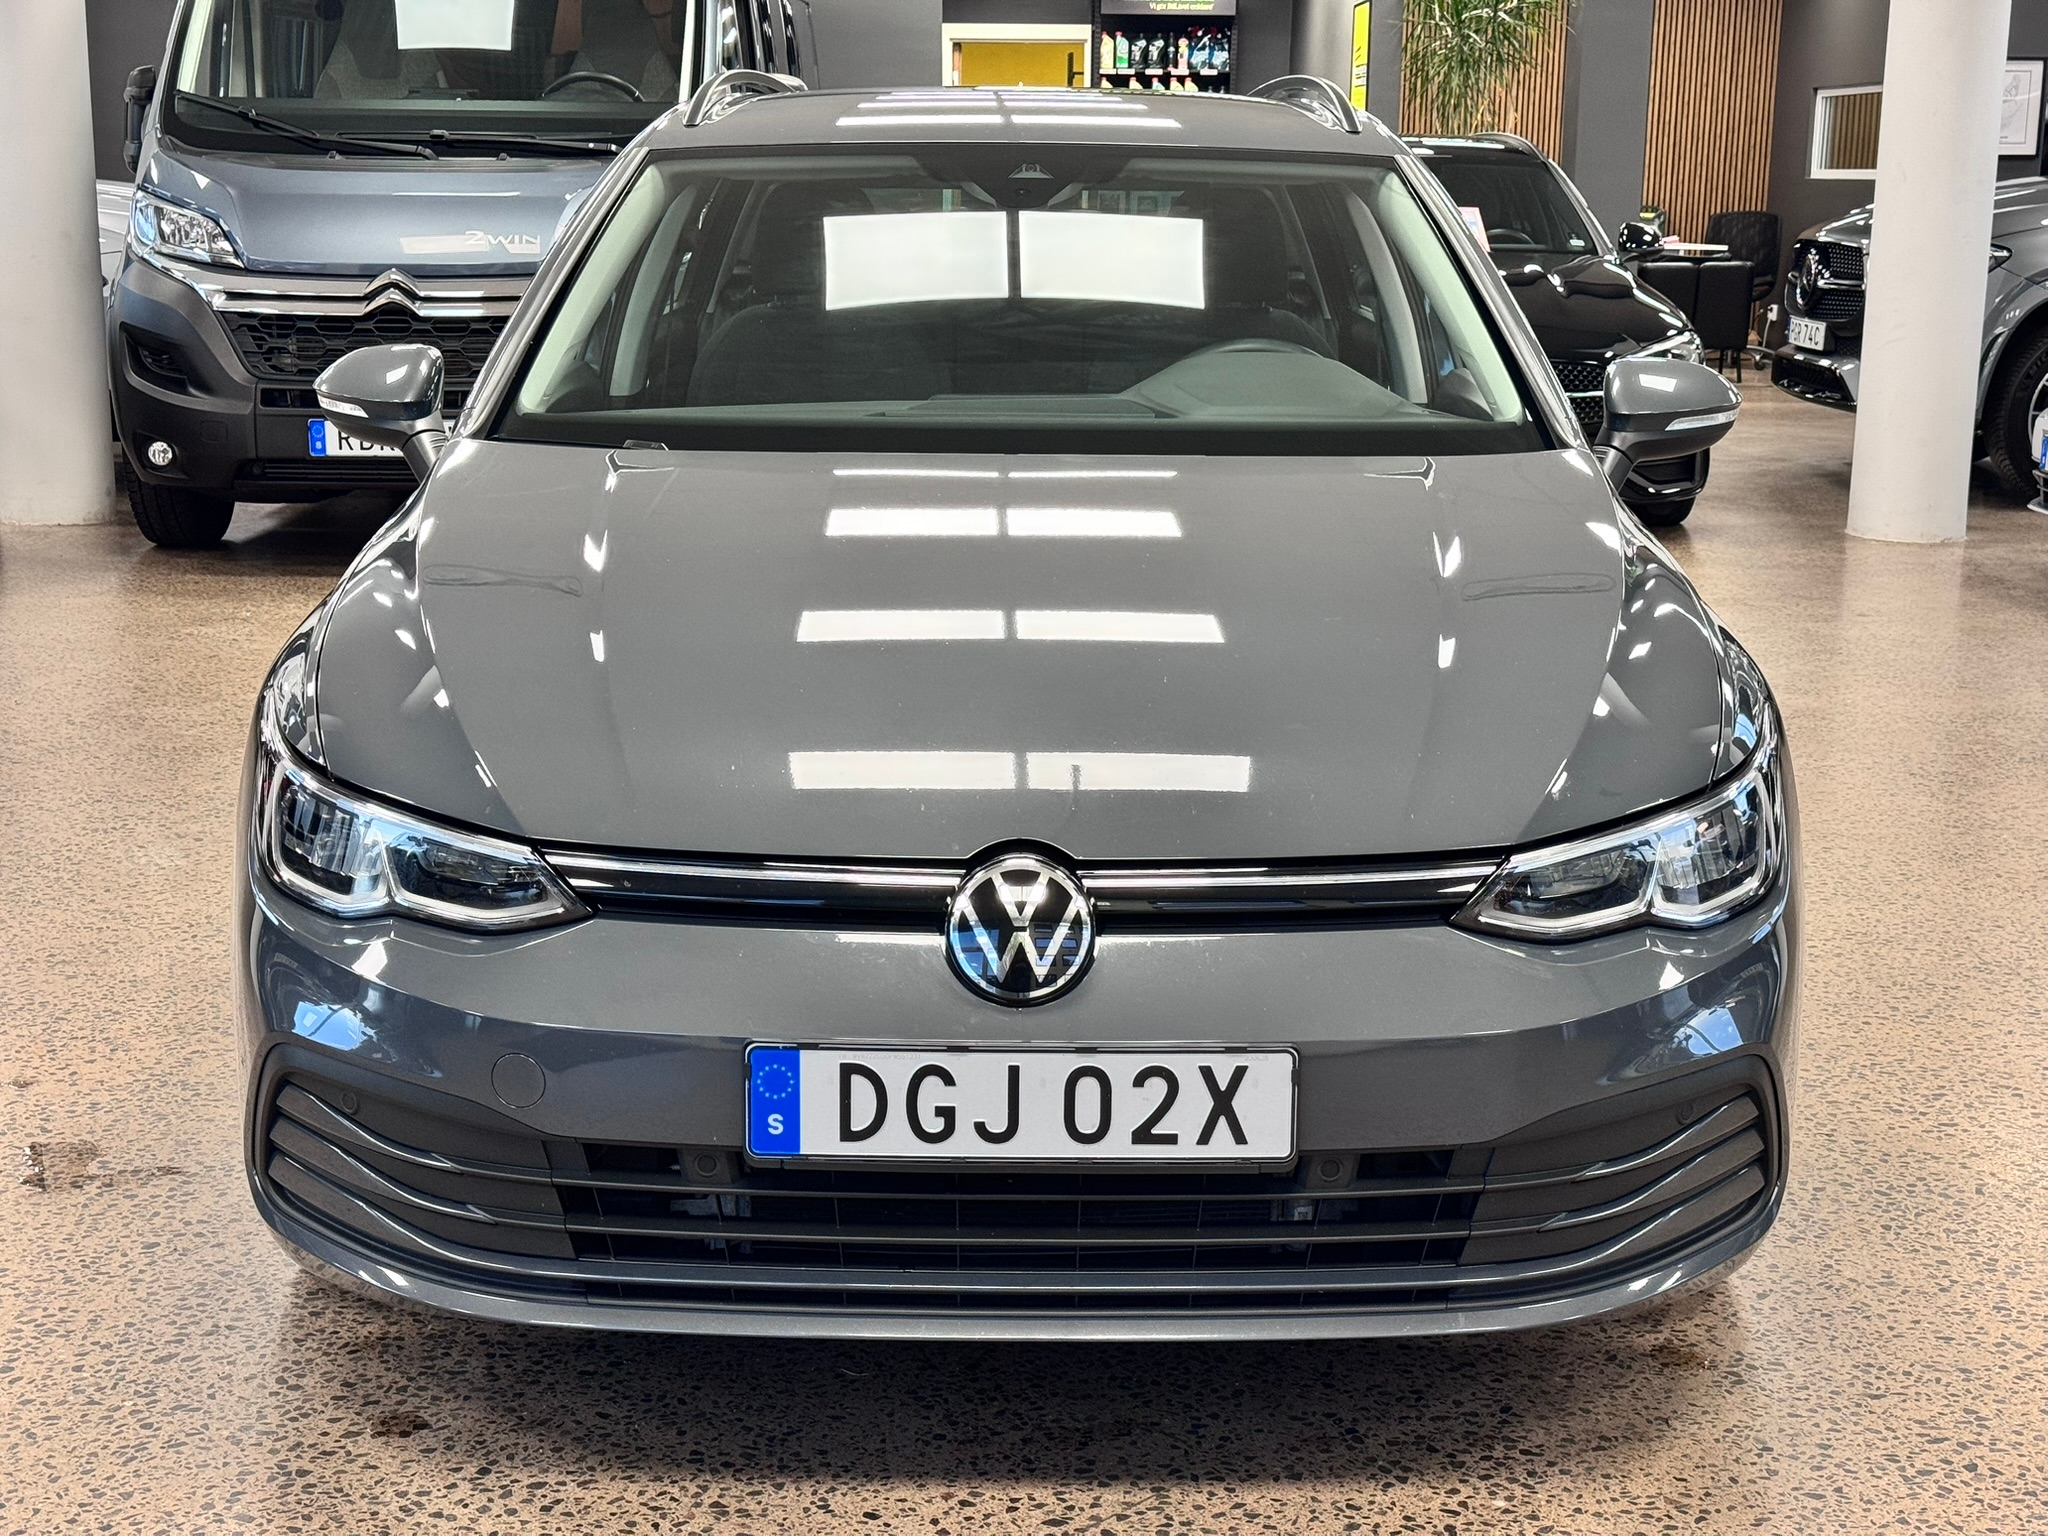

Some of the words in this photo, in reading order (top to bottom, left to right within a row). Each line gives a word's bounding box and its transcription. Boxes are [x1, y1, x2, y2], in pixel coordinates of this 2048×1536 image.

[465, 230, 541, 245] 2WIN
[1803, 323, 1820, 346] 74C
[838, 1061, 1021, 1145] DGJ
[1062, 1064, 1250, 1146] 02X
[767, 1113, 784, 1136] S
